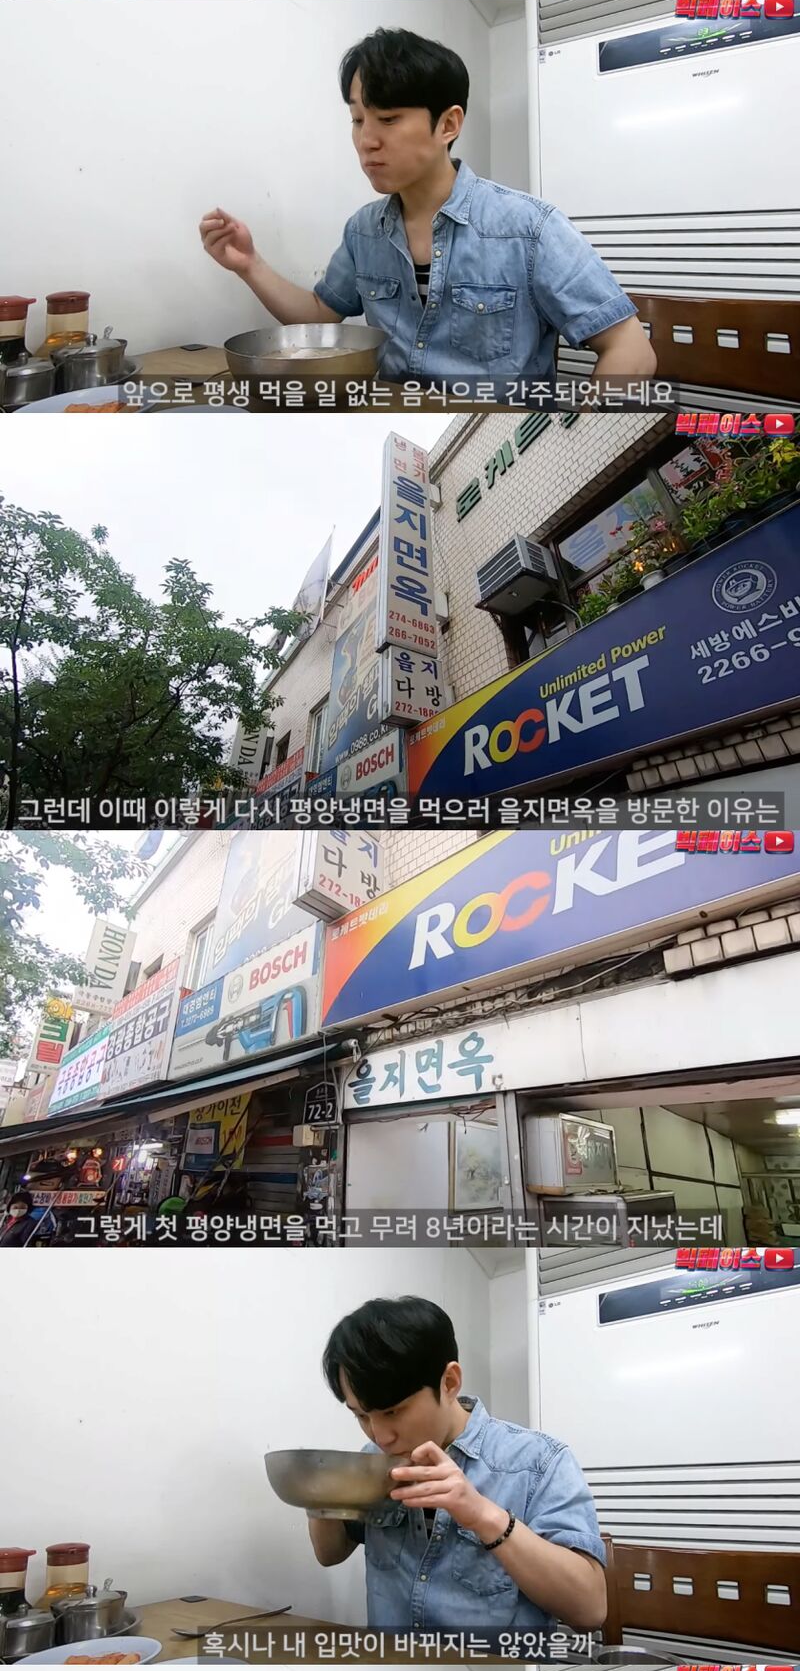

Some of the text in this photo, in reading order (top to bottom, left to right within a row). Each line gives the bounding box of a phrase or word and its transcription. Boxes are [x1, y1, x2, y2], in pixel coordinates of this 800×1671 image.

[392, 475, 432, 616] 을지면옥
[388, 626, 436, 650] 266-7052
[539, 625, 667, 699] Unlimited Power
[394, 651, 438, 681] 을지
[394, 677, 443, 708] 다방
[464, 655, 650, 777] ROCKET
[355, 742, 395, 780] BOSCH
[320, 844, 381, 900] 다방
[89, 925, 127, 990] HONDA
[248, 940, 309, 991] BOSCH
[347, 1031, 494, 1106] 을지면옥
[307, 1102, 333, 1120] 72-2
